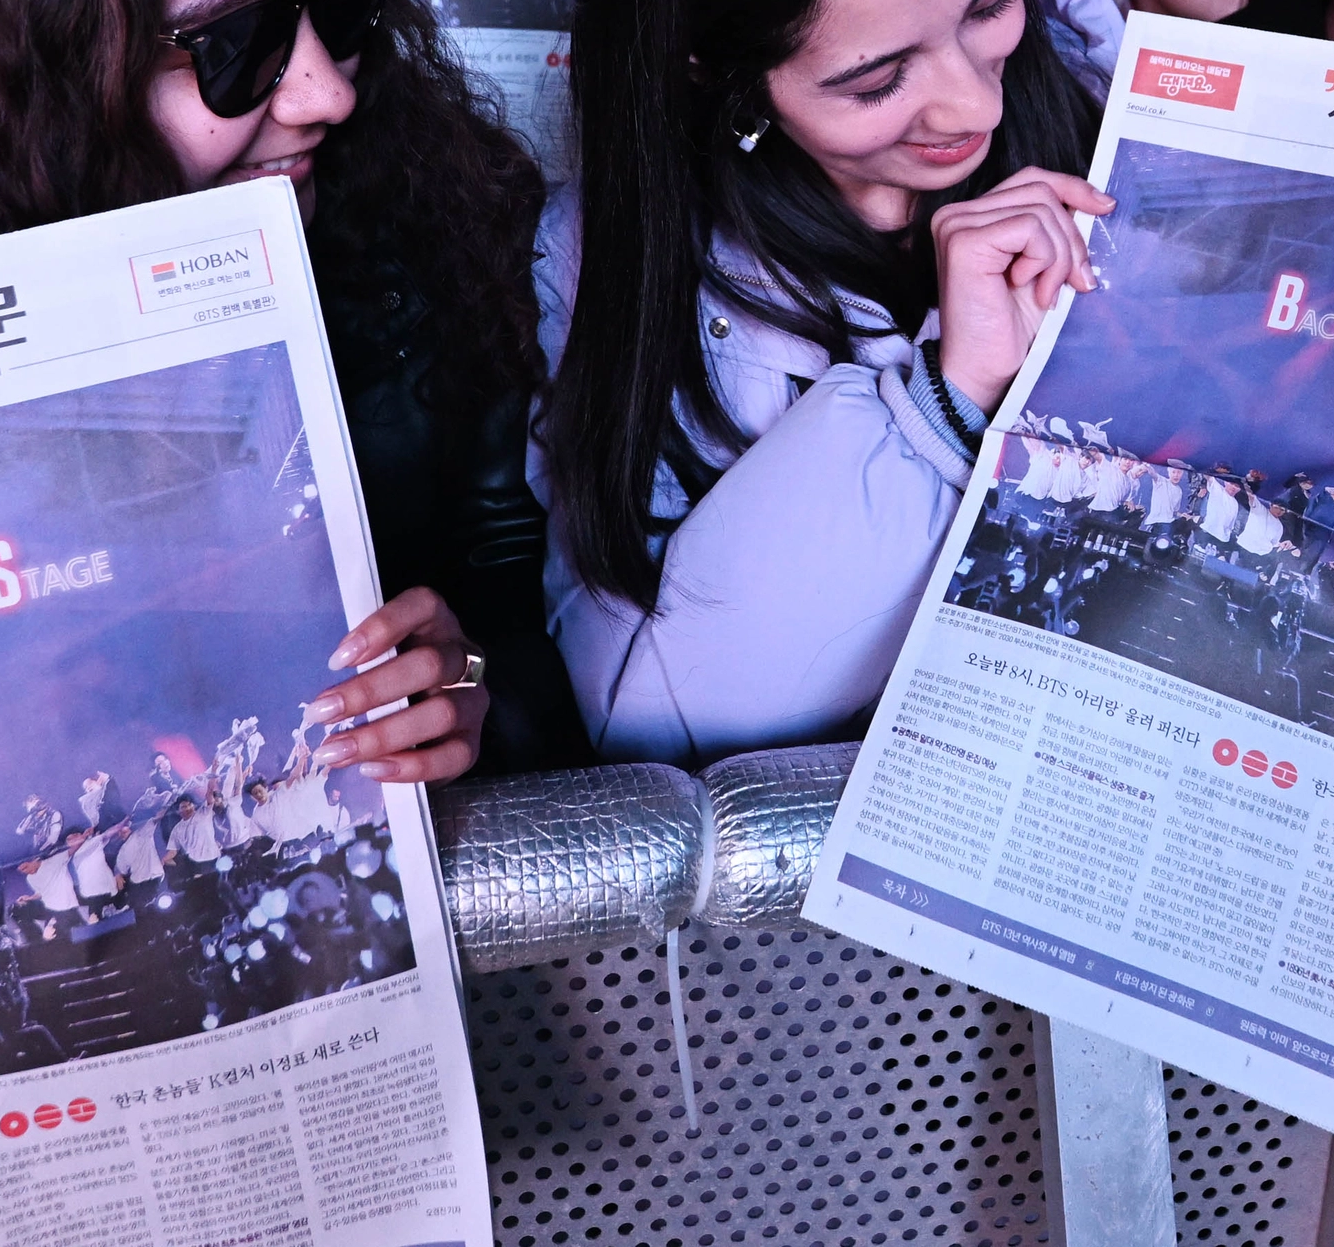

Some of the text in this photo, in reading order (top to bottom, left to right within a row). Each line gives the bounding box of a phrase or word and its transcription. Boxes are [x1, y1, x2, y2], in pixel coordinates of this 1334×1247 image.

[179, 246, 249, 275] HOBAN
[157, 268, 251, 298] 변화와 혁신으로 여는 미래
[220, 301, 241, 317] 컴백
[963, 651, 1008, 676] 오늘밤
[1007, 664, 1034, 687] 8시,
[1036, 673, 1069, 698] BTS
[1124, 707, 1154, 731] 울려
[1156, 719, 1201, 749] 퍼진다
[881, 877, 907, 899] 목차
[980, 918, 1002, 935] BTS
[1002, 926, 1022, 943] 13년
[1021, 933, 1048, 953] 역사와
[1047, 944, 1059, 957] 새
[1139, 979, 1158, 996] 성지
[1239, 1018, 1267, 1039] 원동력
[208, 1062, 255, 1089] K컬처
[258, 1050, 309, 1075] 이정표
[311, 1039, 345, 1060] 새로
[347, 1025, 380, 1051] 쓴다
